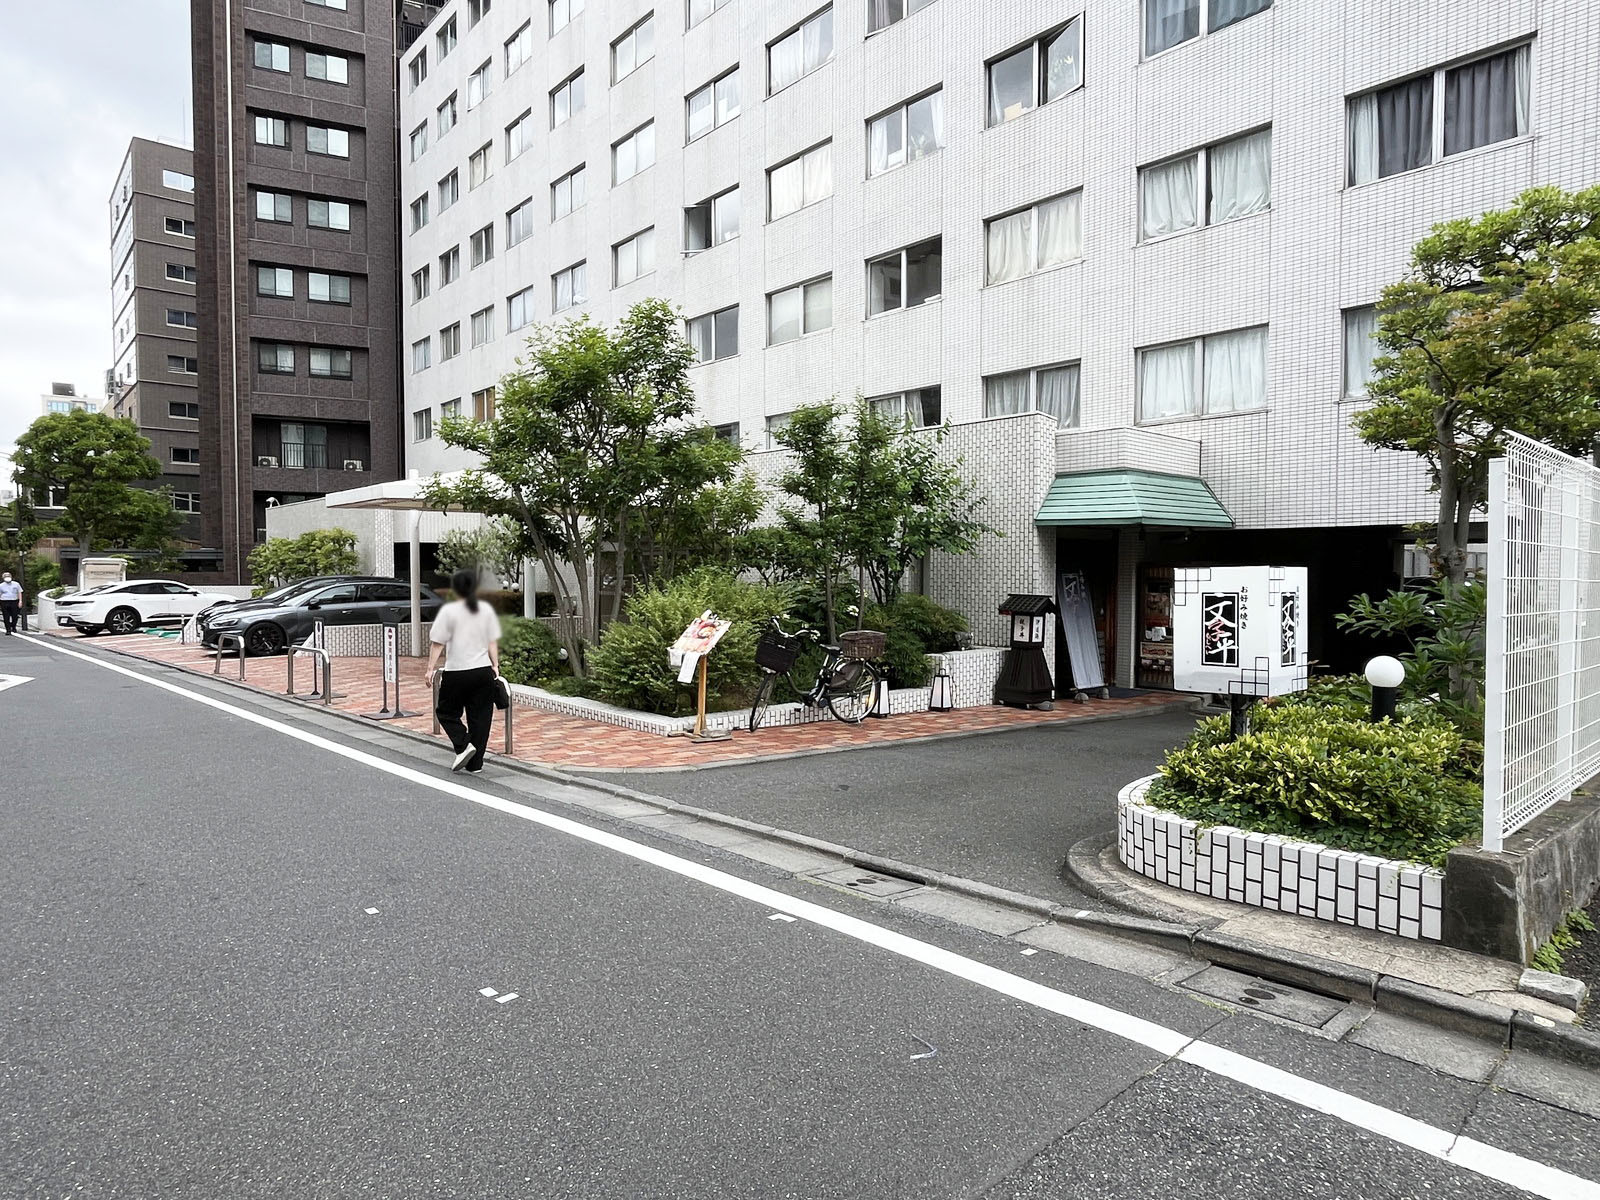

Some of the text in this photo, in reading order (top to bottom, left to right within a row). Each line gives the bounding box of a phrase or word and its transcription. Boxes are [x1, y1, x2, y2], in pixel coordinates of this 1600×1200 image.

[1240, 586, 1248, 629] お好み焼き
